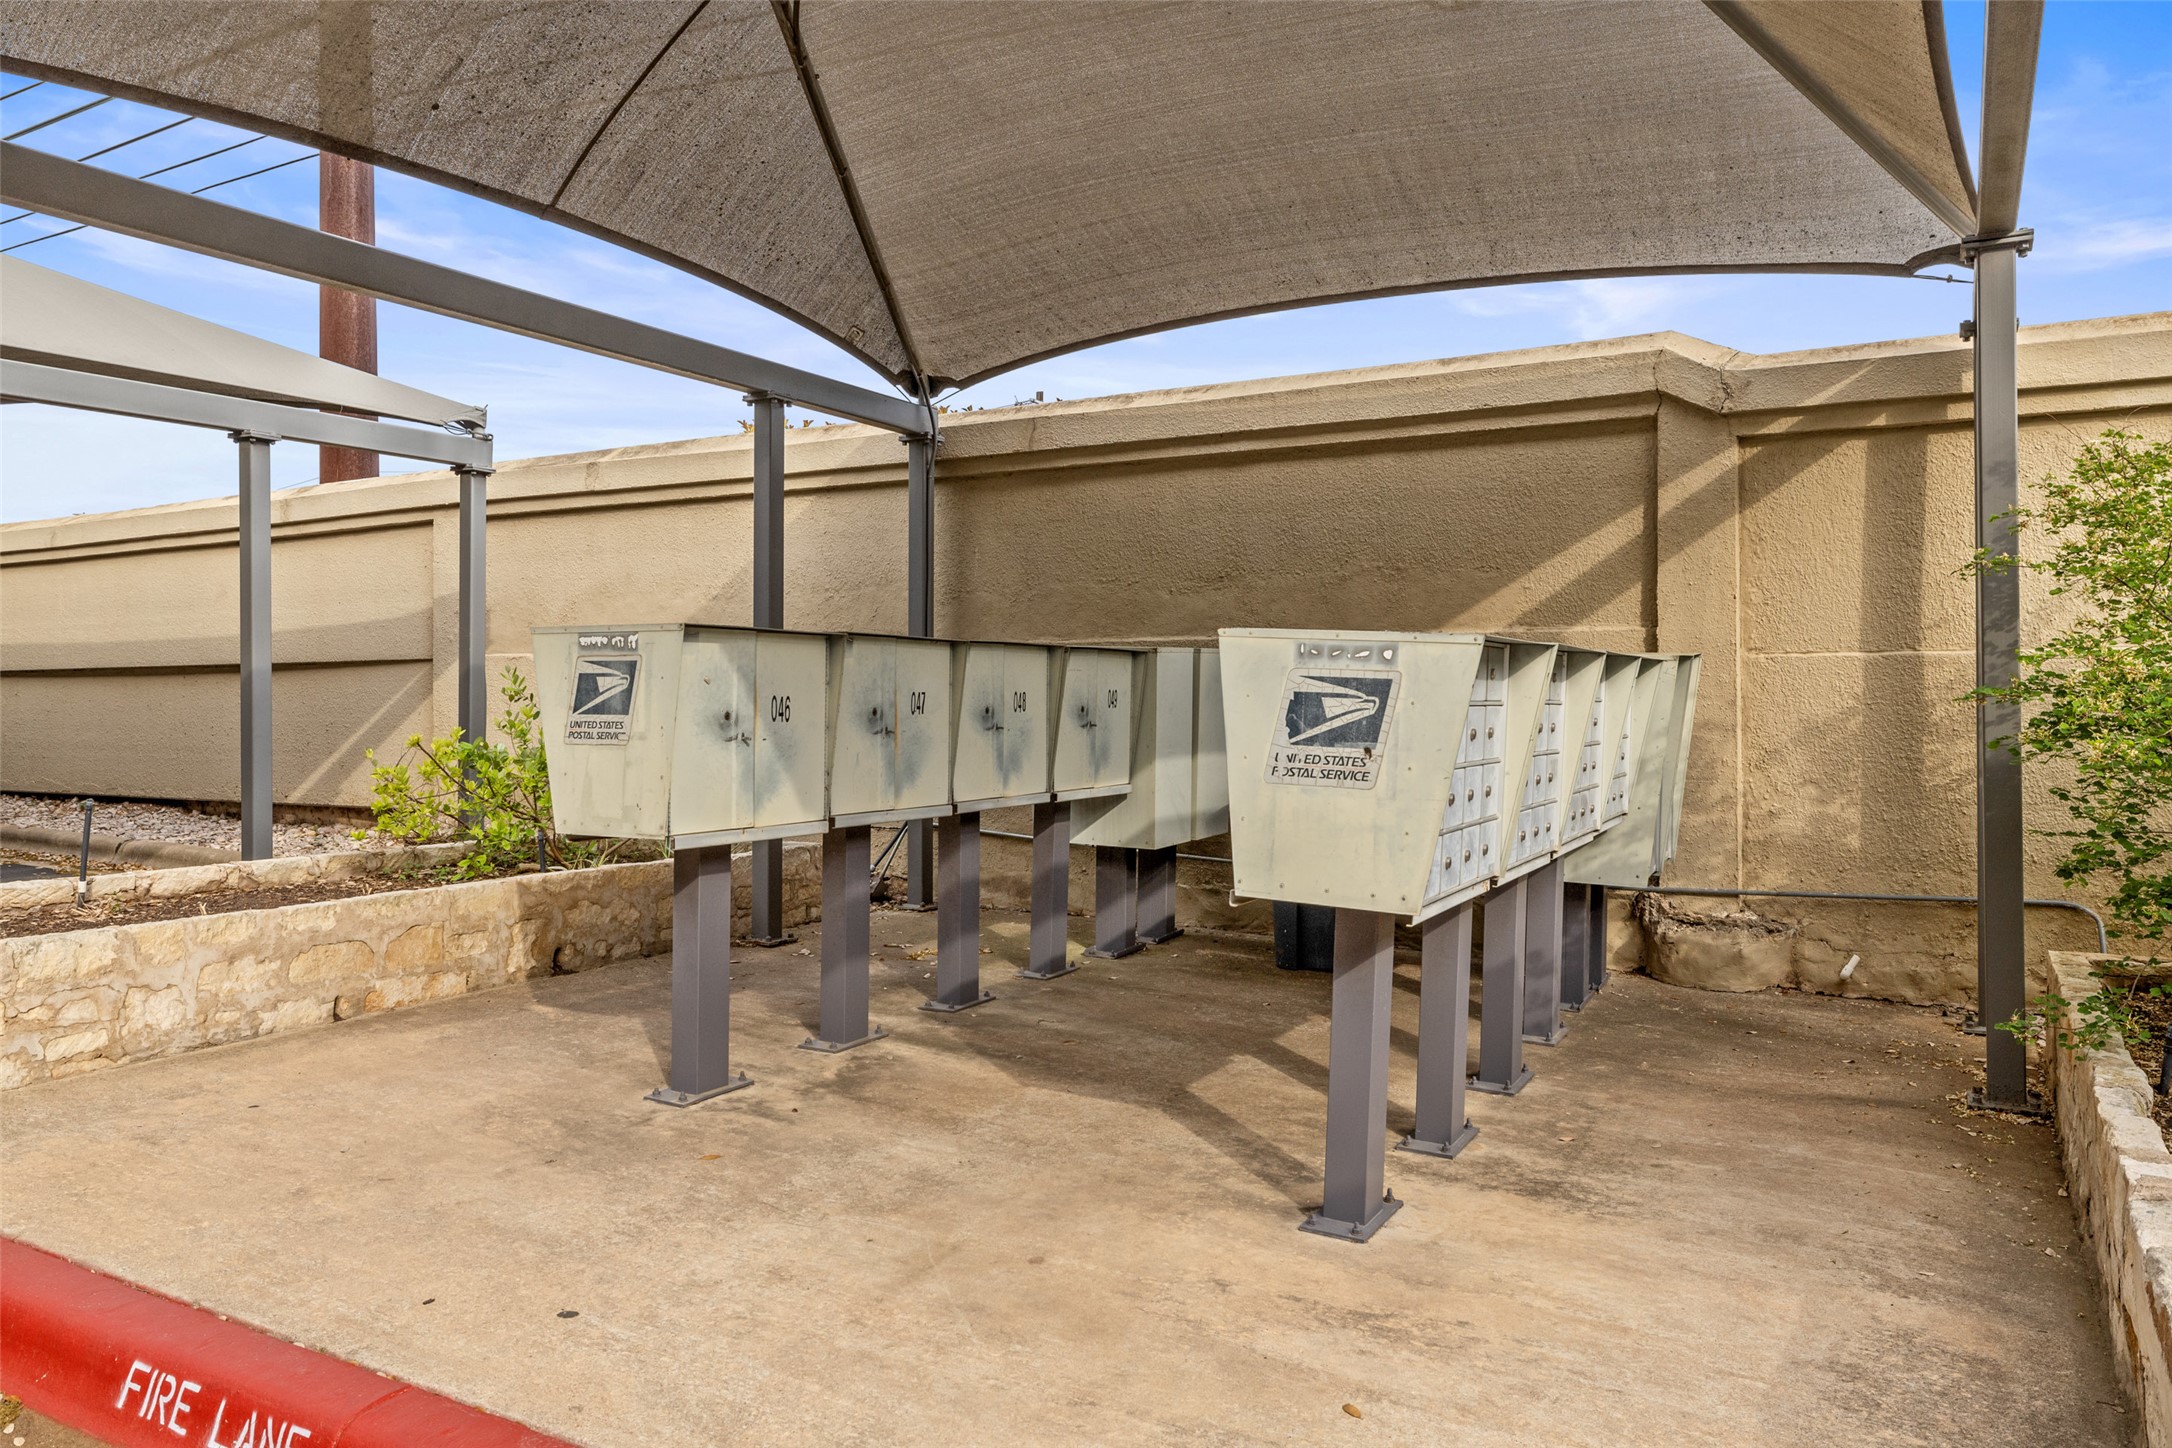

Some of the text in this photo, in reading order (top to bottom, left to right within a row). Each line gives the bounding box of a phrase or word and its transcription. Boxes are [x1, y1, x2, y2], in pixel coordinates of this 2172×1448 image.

[770, 695, 791, 723] 046
[910, 691, 926, 715] 047
[1012, 691, 1027, 713] 048
[1107, 689, 1118, 709] 049
[569, 720, 625, 729] UNITED STATES
[567, 731, 626, 740] POSTAL SERVIC
[1322, 755, 1367, 768] STATES
[1318, 768, 1371, 782] SERVICE
[115, 1360, 202, 1436] FIRE
